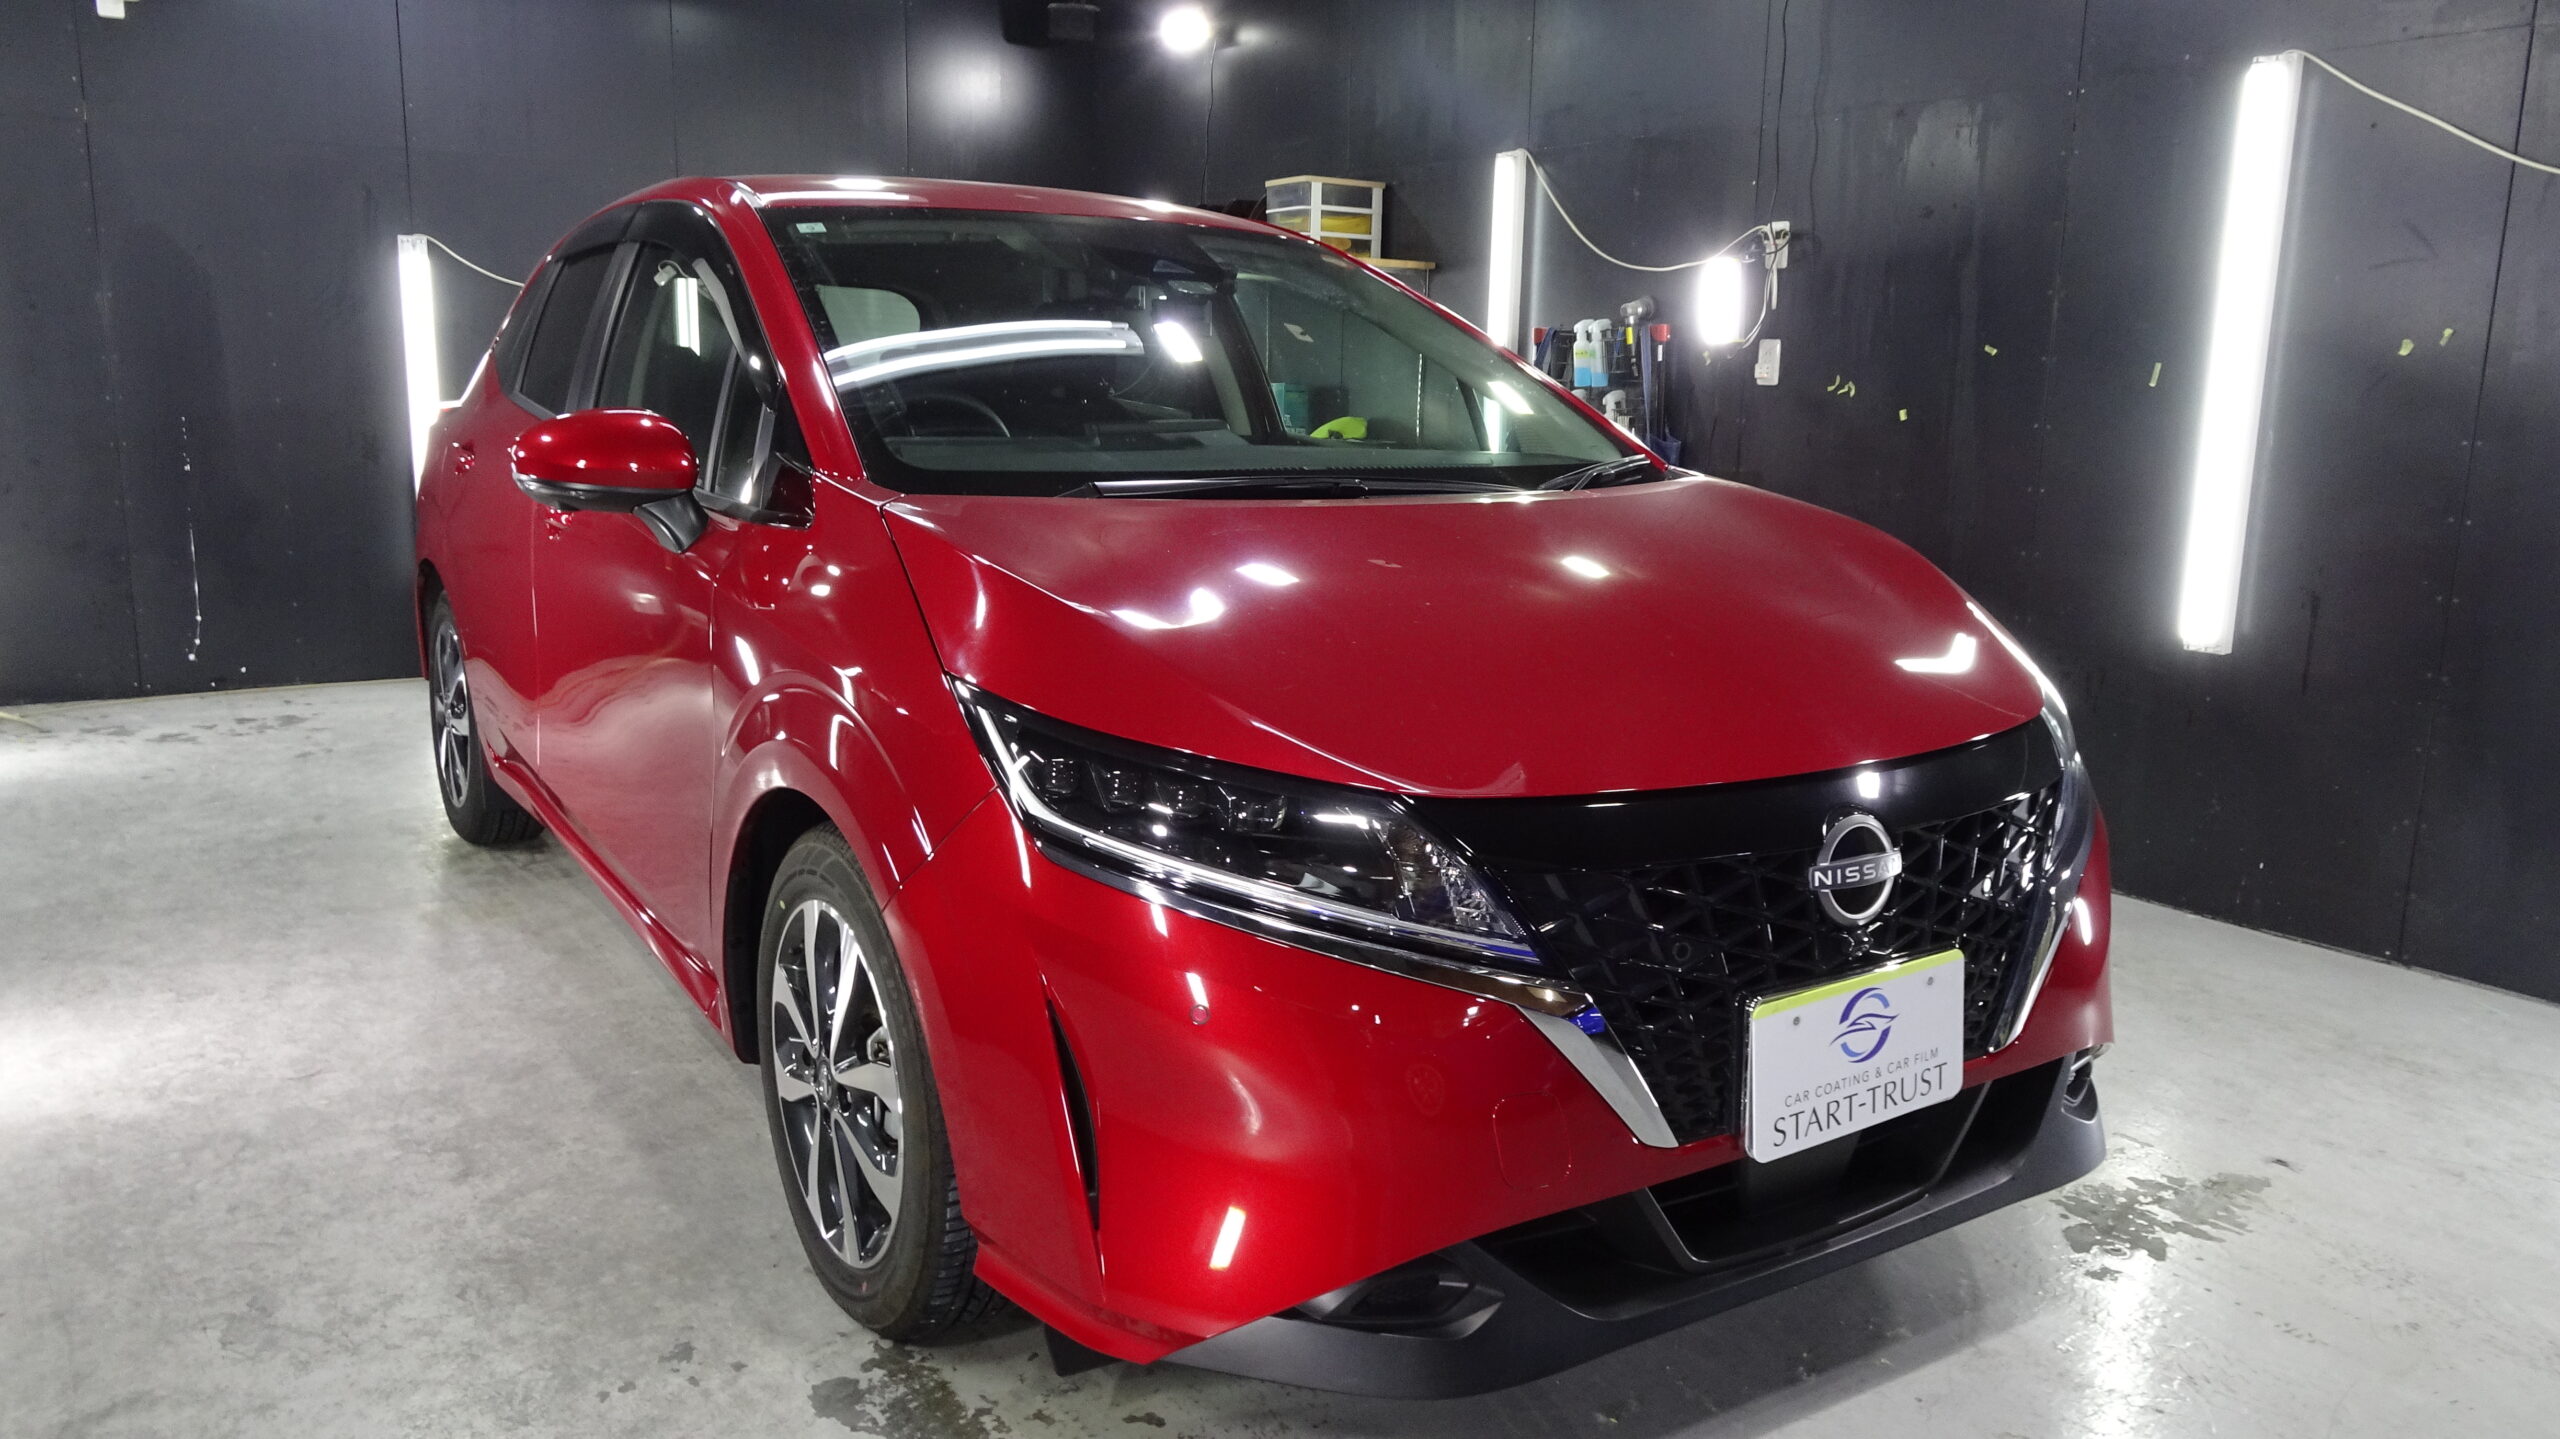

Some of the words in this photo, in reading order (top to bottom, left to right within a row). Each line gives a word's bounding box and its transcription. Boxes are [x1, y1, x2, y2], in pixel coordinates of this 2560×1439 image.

[1773, 1062, 1948, 1147] START-TRUST
[1785, 1090, 1810, 1107] CAR
[1815, 1071, 1869, 1098] COATING
[1875, 1067, 1882, 1078] &
[1887, 1057, 1909, 1074] CAR
[1914, 1047, 1939, 1066] FILM
